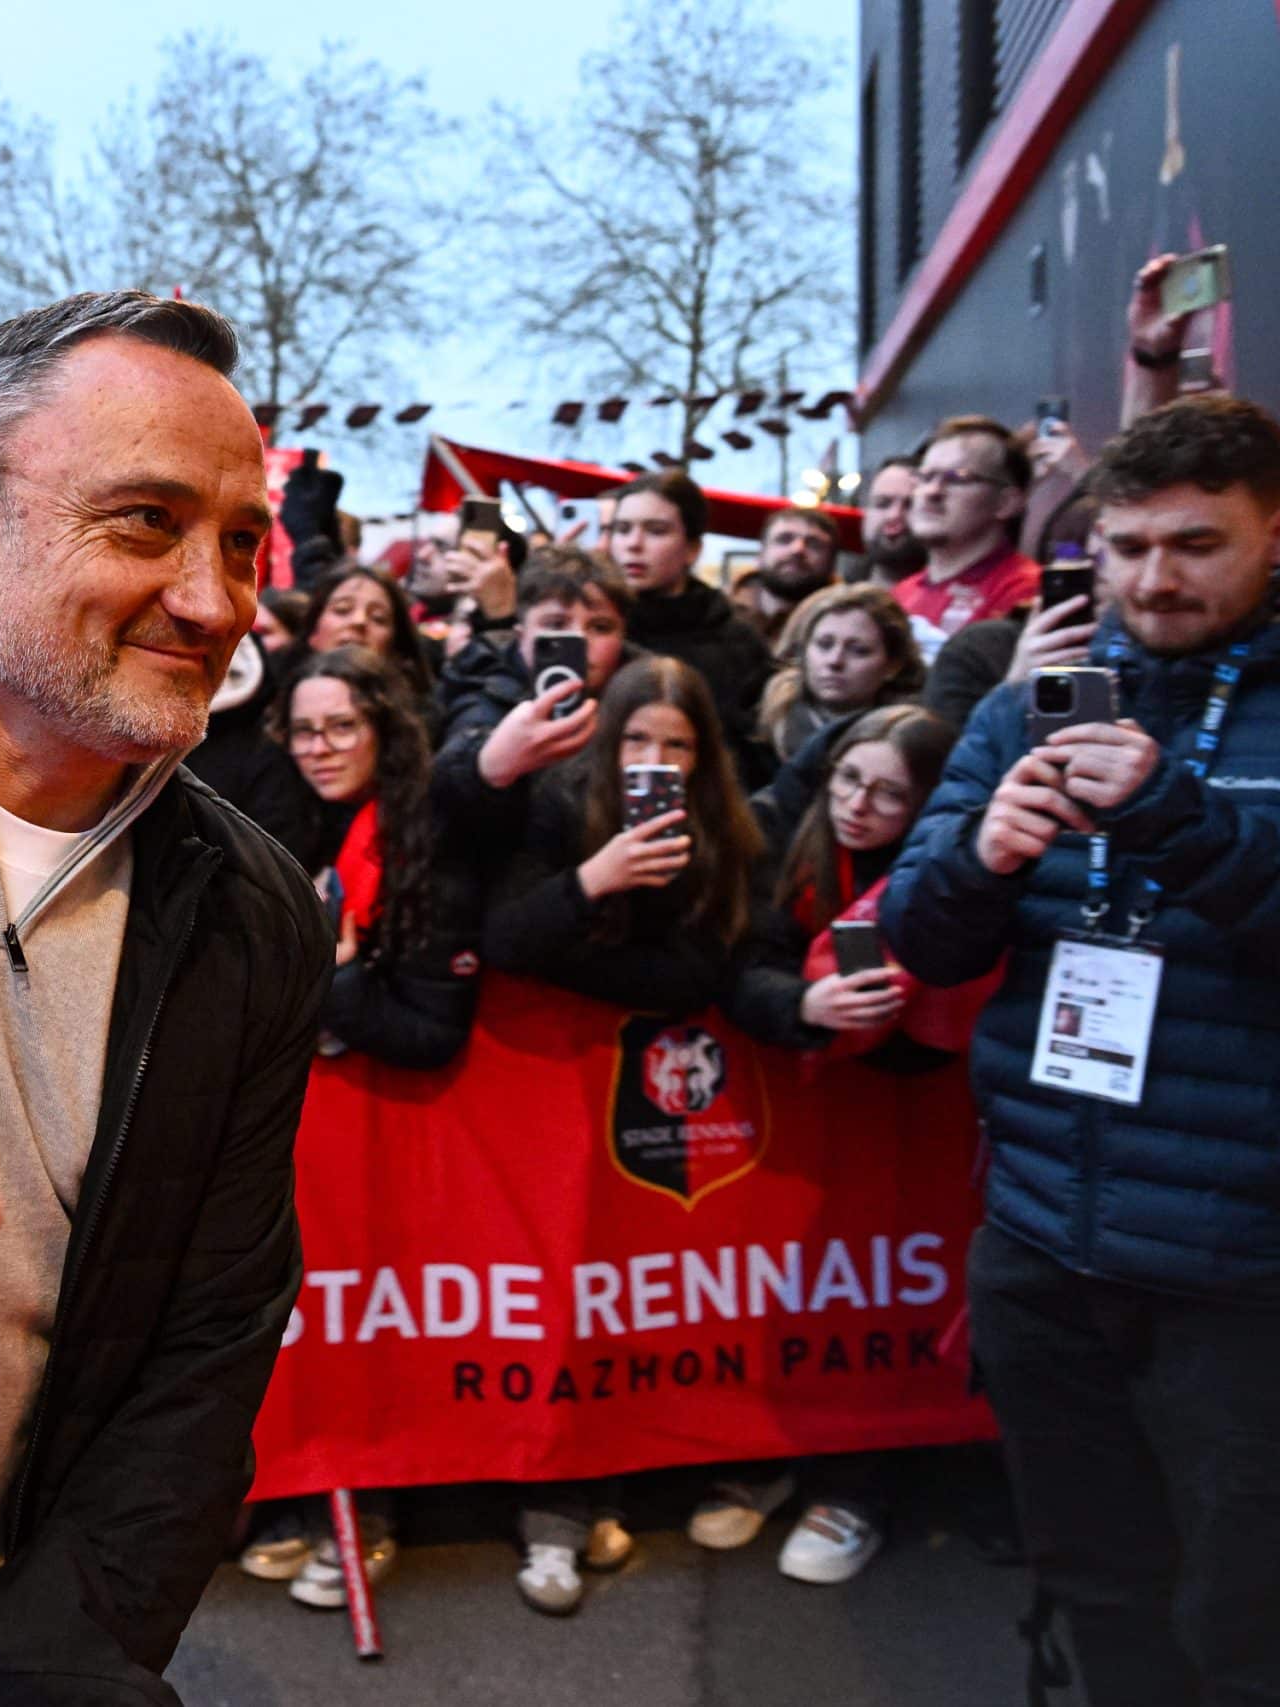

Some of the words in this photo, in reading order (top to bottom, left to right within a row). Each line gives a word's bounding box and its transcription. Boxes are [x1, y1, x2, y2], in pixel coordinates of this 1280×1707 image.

[572, 1232, 949, 1341] RENNAIS
[453, 1343, 747, 1405] ROAZHON
[779, 1329, 943, 1376] PARK
